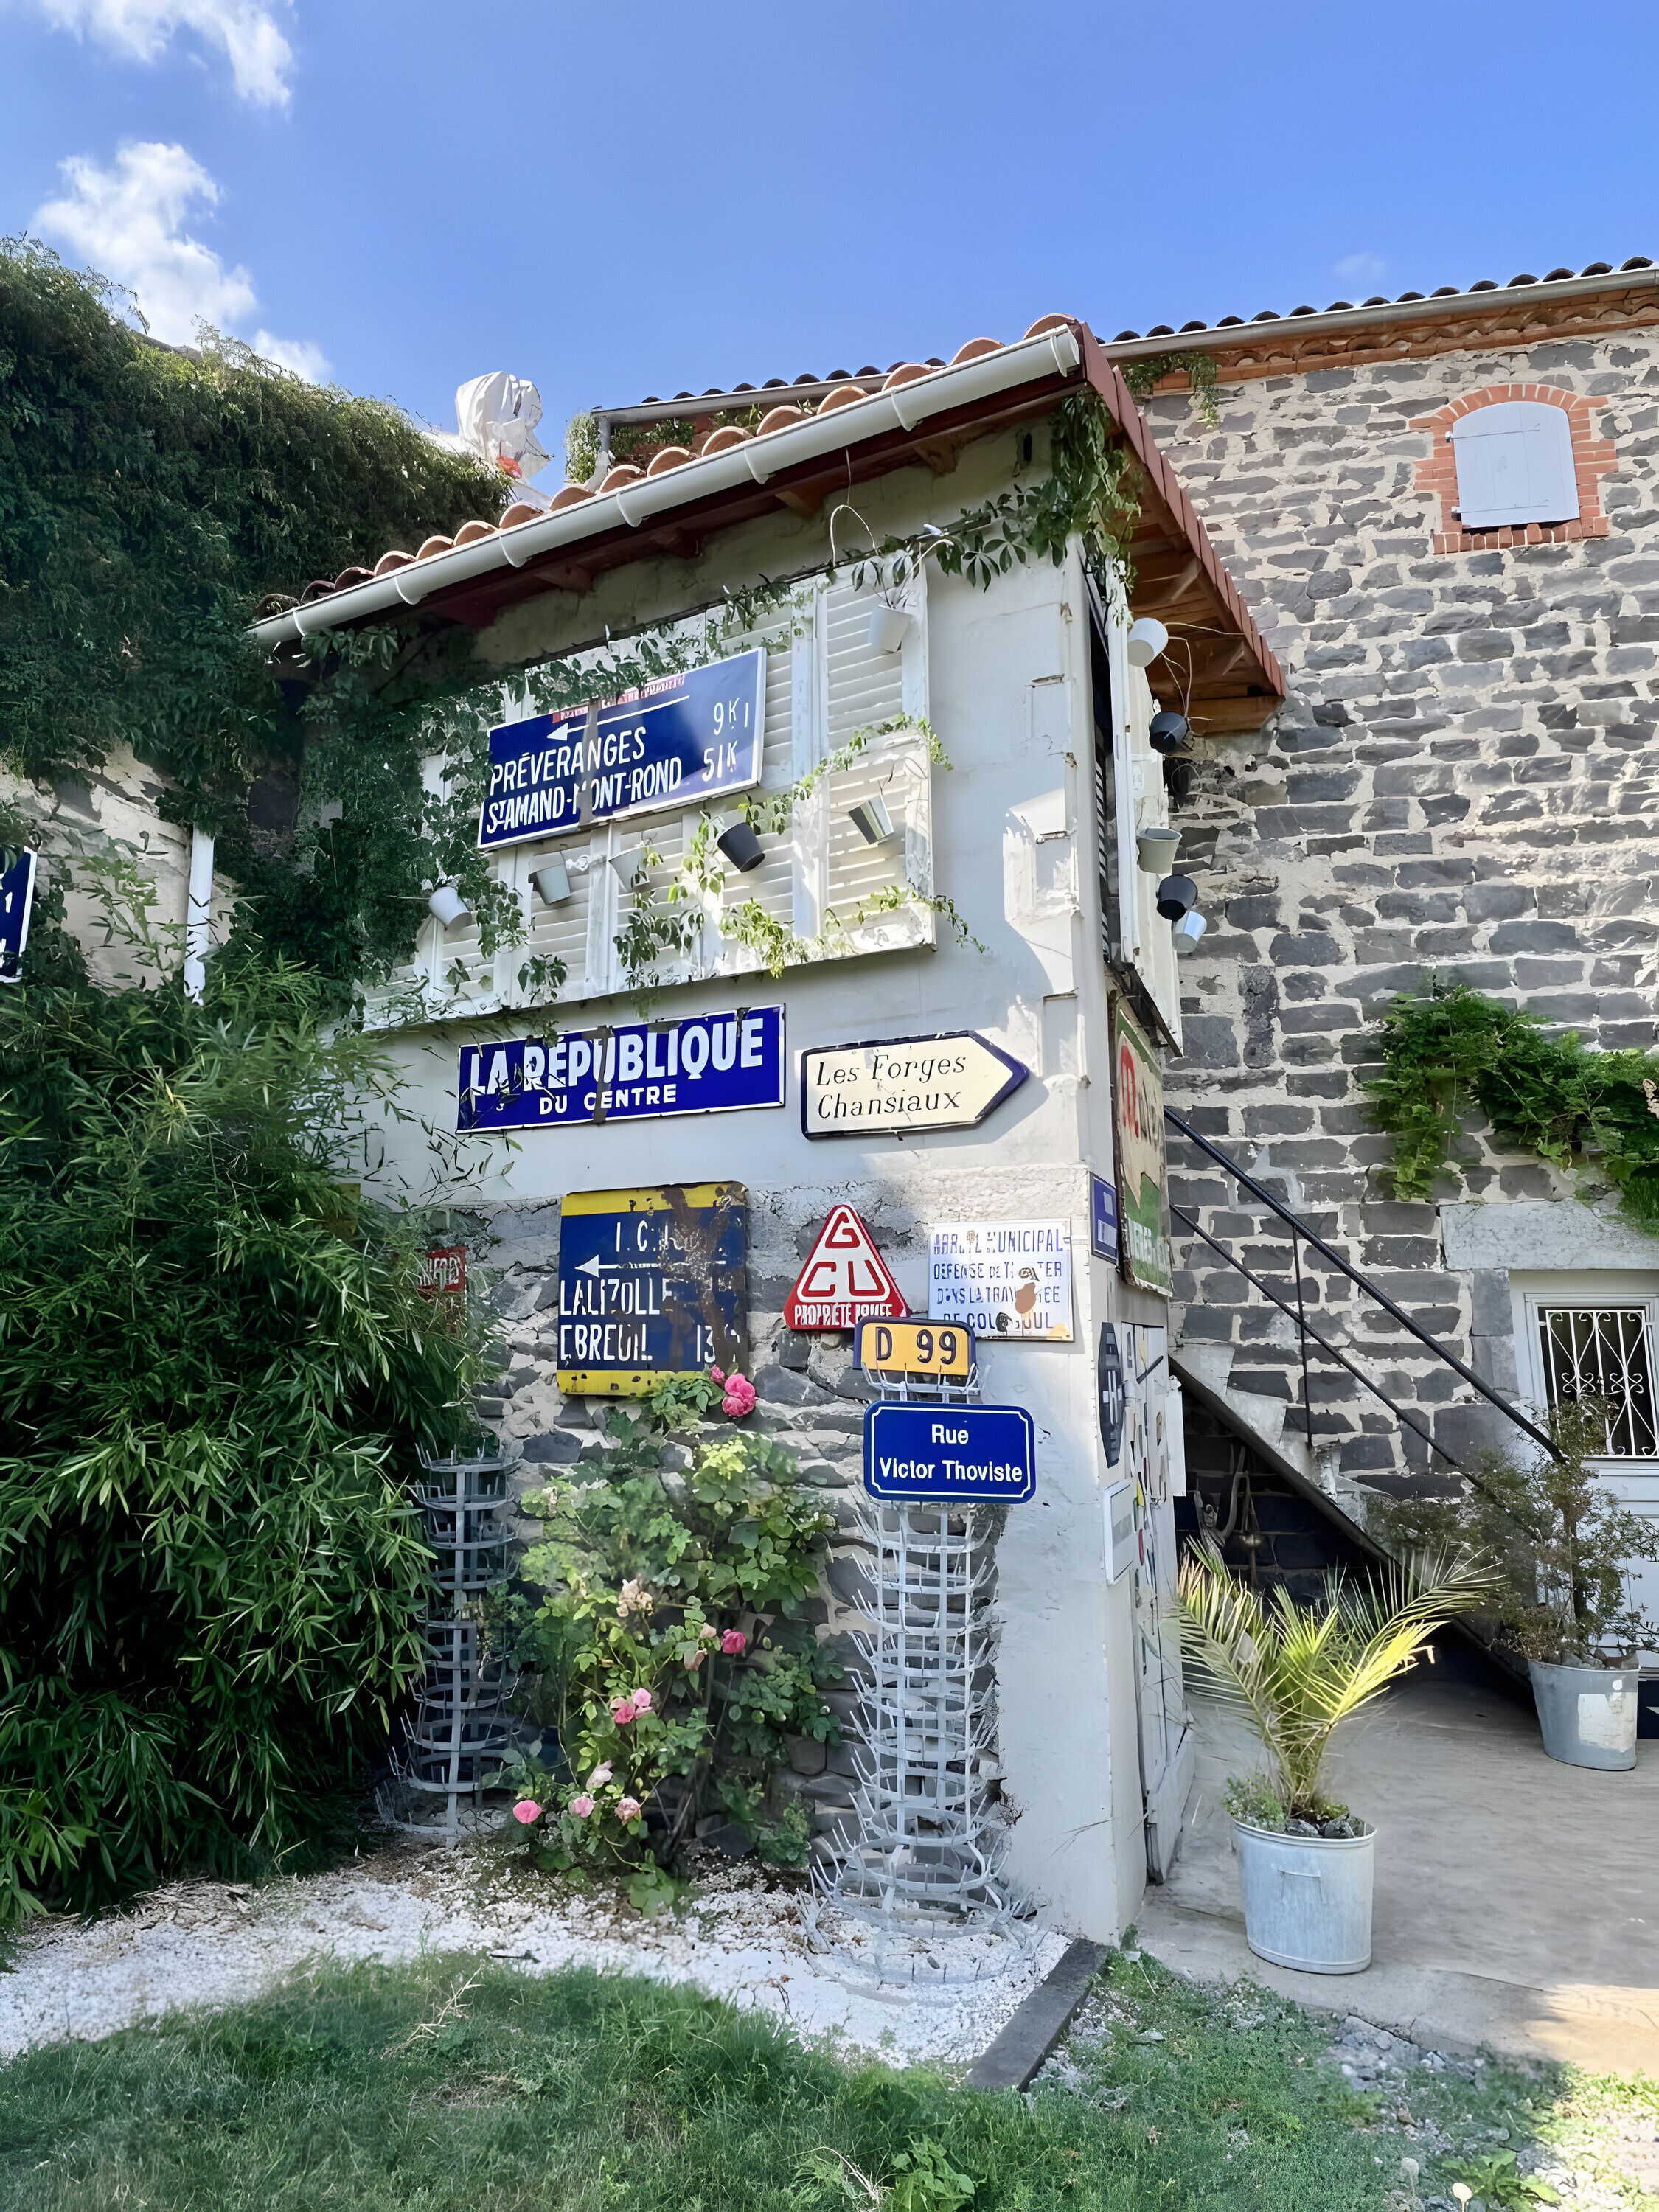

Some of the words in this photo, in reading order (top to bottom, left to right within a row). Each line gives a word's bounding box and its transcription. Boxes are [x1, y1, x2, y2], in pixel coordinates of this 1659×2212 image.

[470, 1049, 510, 1095] LA
[523, 1018, 764, 1091] RÉPUBLIQUE
[816, 1061, 859, 1086] Les
[870, 1054, 966, 1083] Forges
[540, 1095, 567, 1115] DU
[584, 1084, 676, 1110] CENTRE
[818, 1089, 961, 1119] Chansiaux
[875, 1326, 893, 1361] D
[916, 1329, 956, 1364] 99
[931, 1424, 969, 1444] Rue
[880, 1457, 935, 1479] Victor
[942, 1460, 1023, 1482] Thoviste
